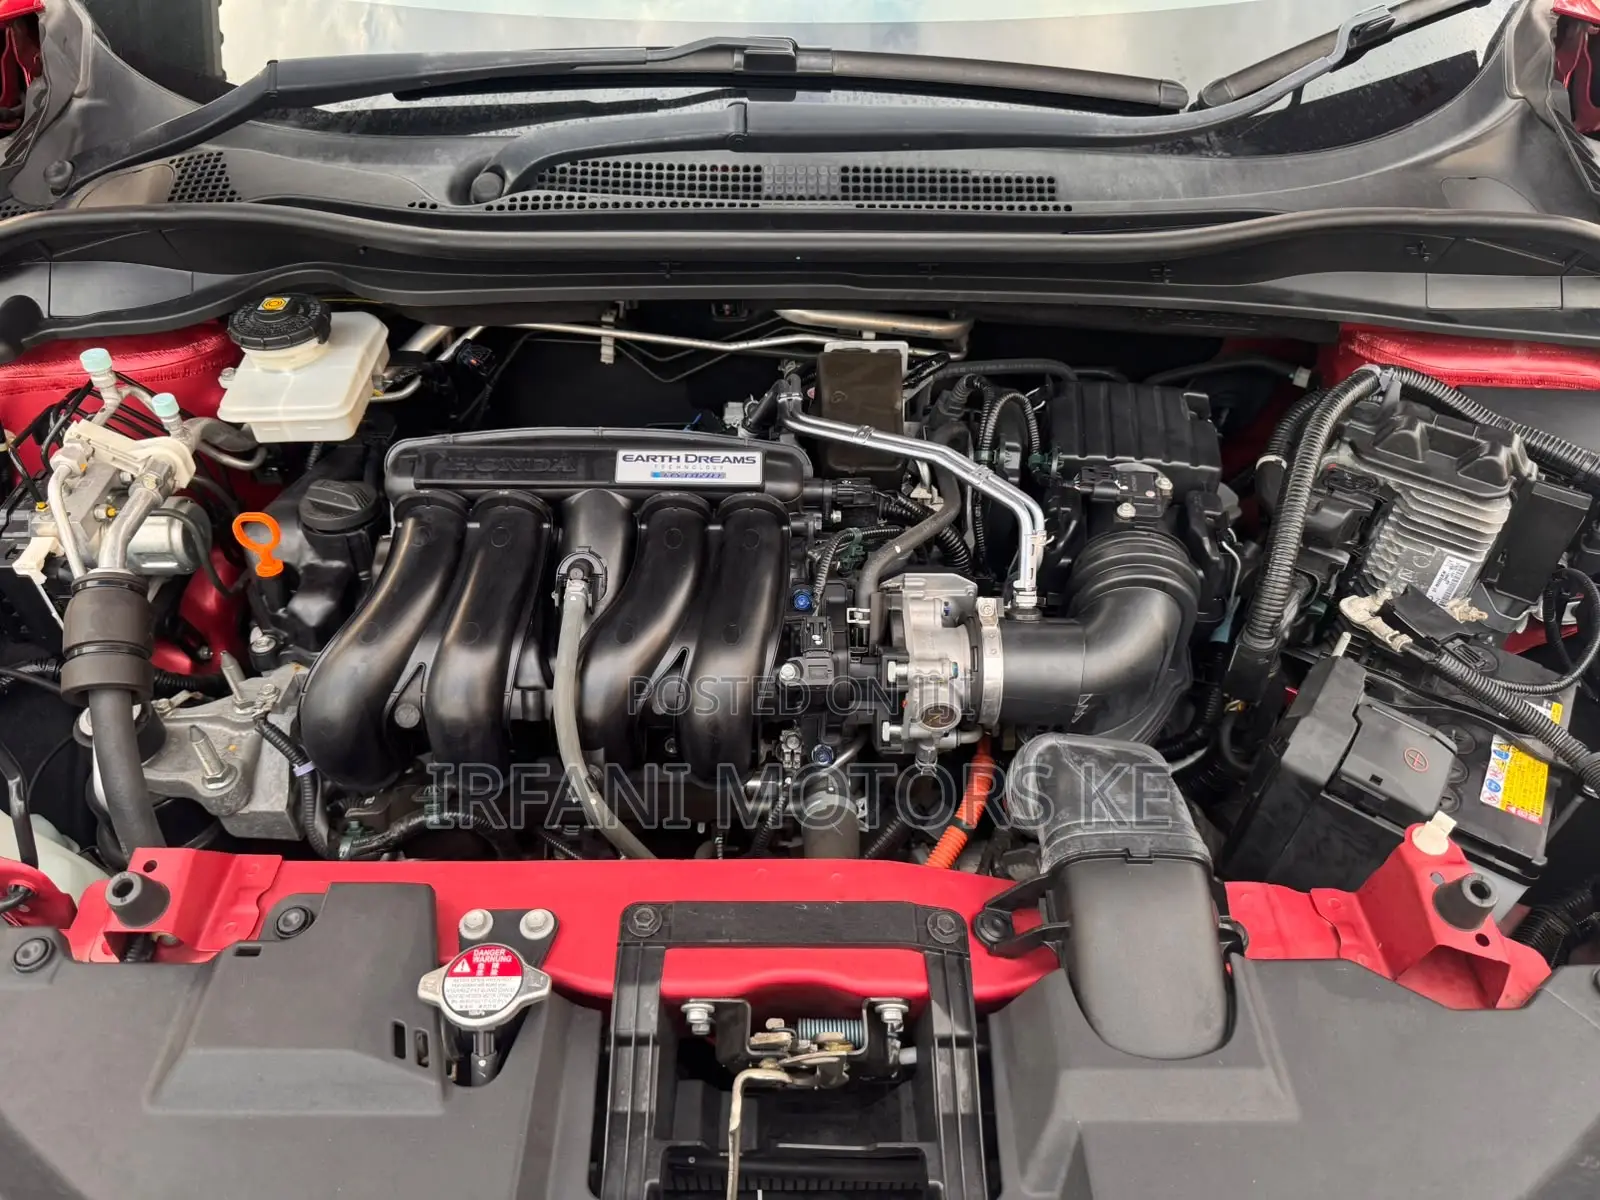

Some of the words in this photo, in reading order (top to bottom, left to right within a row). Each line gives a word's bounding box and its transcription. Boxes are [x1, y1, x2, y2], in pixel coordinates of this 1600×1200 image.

[447, 456, 577, 472] HONDA
[622, 454, 680, 463] EARTH
[684, 454, 756, 464] DREAMS
[473, 948, 506, 956] DANGER
